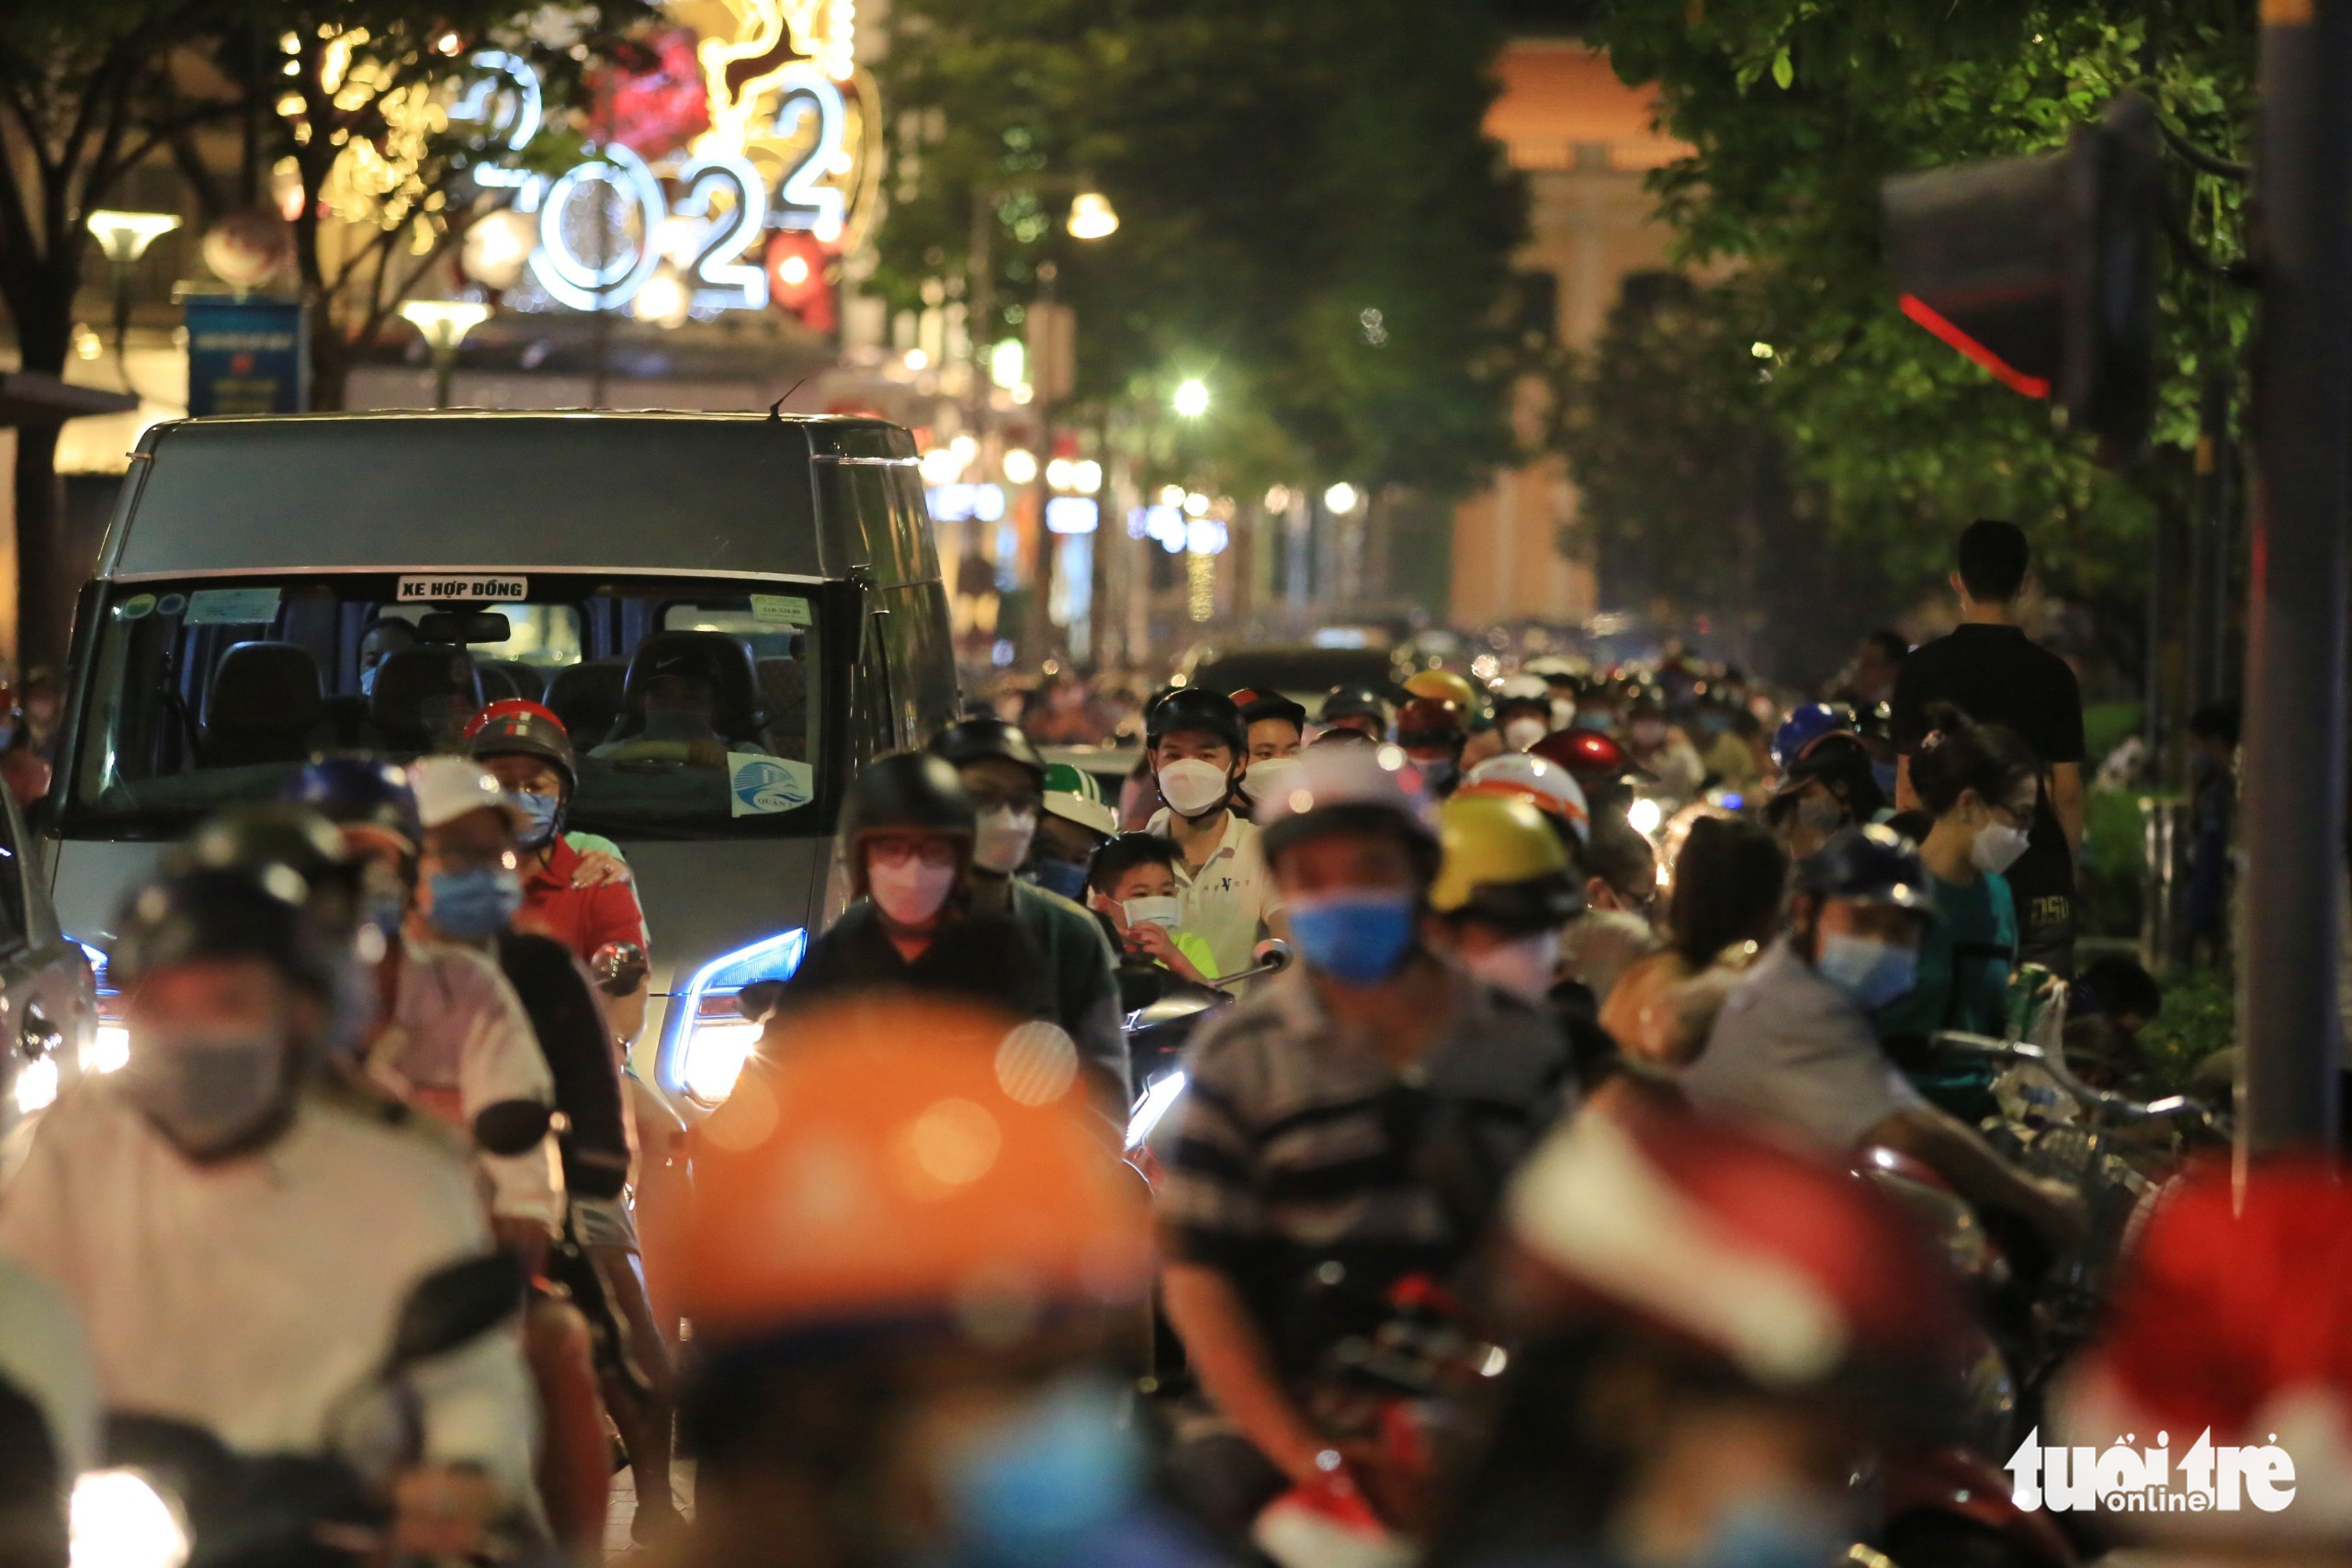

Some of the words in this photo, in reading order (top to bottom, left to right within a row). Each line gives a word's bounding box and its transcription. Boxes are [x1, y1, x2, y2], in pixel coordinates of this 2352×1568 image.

[402, 582, 426, 596] XE
[430, 581, 468, 598] HỢP
[471, 580, 522, 596] ĐỒNG
